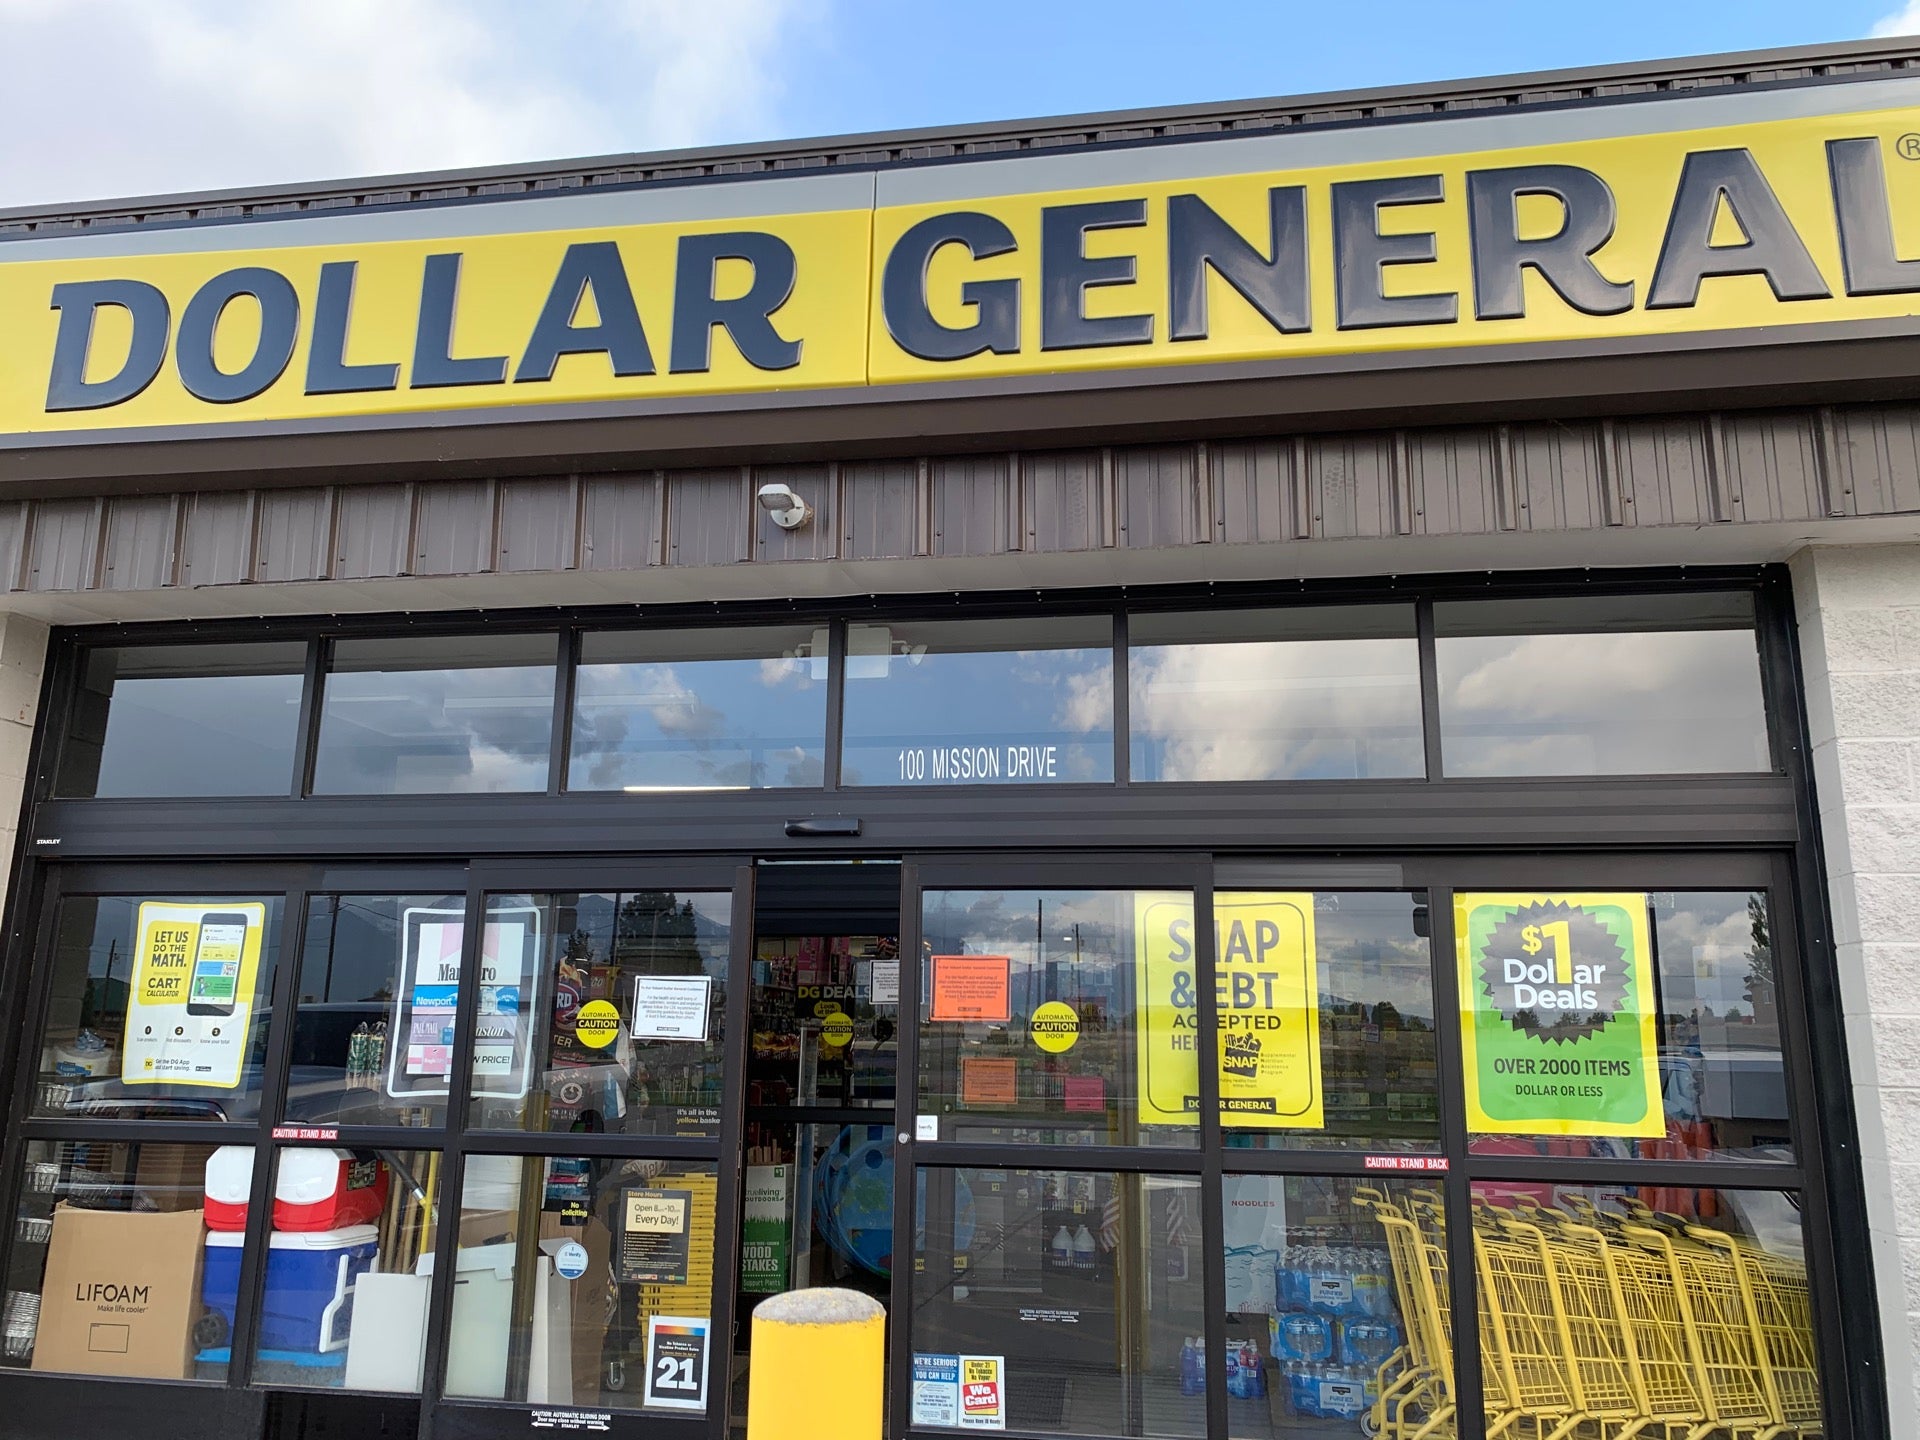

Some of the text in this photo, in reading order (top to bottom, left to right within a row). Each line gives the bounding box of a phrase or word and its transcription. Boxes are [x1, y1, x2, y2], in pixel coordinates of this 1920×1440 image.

[45, 231, 804, 414] DOLLAR
[881, 135, 1920, 362] GENERAL
[899, 746, 1057, 780] 100 MISSION DRIVE
[155, 930, 189, 943] LET US
[153, 944, 187, 953] DO THE
[151, 953, 187, 967] MATH.
[148, 977, 181, 989] CART
[1170, 970, 1196, 1008] &
[146, 989, 179, 997] CALCULATOR
[798, 986, 820, 998] DG
[1513, 984, 1598, 1010] Deals
[416, 997, 452, 1006] Newport
[578, 1019, 617, 1028] CAUTION
[1034, 1022, 1077, 1031] CAUTION
[1172, 1014, 1282, 1030] ACEPTED
[482, 1055, 510, 1064] PRICE!
[1223, 1056, 1259, 1069] SNAP
[1494, 1058, 1632, 1076] OVER 2000 ITEMS
[1515, 1084, 1603, 1097] DOLLAR OR LESS
[1228, 1101, 1272, 1110] GENERAL
[688, 1108, 697, 1116] all
[698, 1108, 705, 1116] in
[706, 1108, 717, 1116] the
[676, 1117, 698, 1125] yellow
[273, 1128, 337, 1140] CAUTION STAND BACK
[1366, 1157, 1448, 1169] CAUTION STAND BACK
[561, 1209, 588, 1217] Soliciting
[634, 1204, 653, 1213] Open
[635, 1214, 679, 1227] Every Day!
[742, 1259, 778, 1272] STAKES
[76, 1283, 149, 1303] LIFOAM
[914, 1357, 957, 1367] WE'RE SERIOUS
[656, 1356, 698, 1390] 21
[916, 1371, 956, 1380] YOU CAN HELP
[969, 1384, 991, 1395] We
[965, 1393, 997, 1406] Card
[553, 1411, 580, 1419] AUTOMATIC
